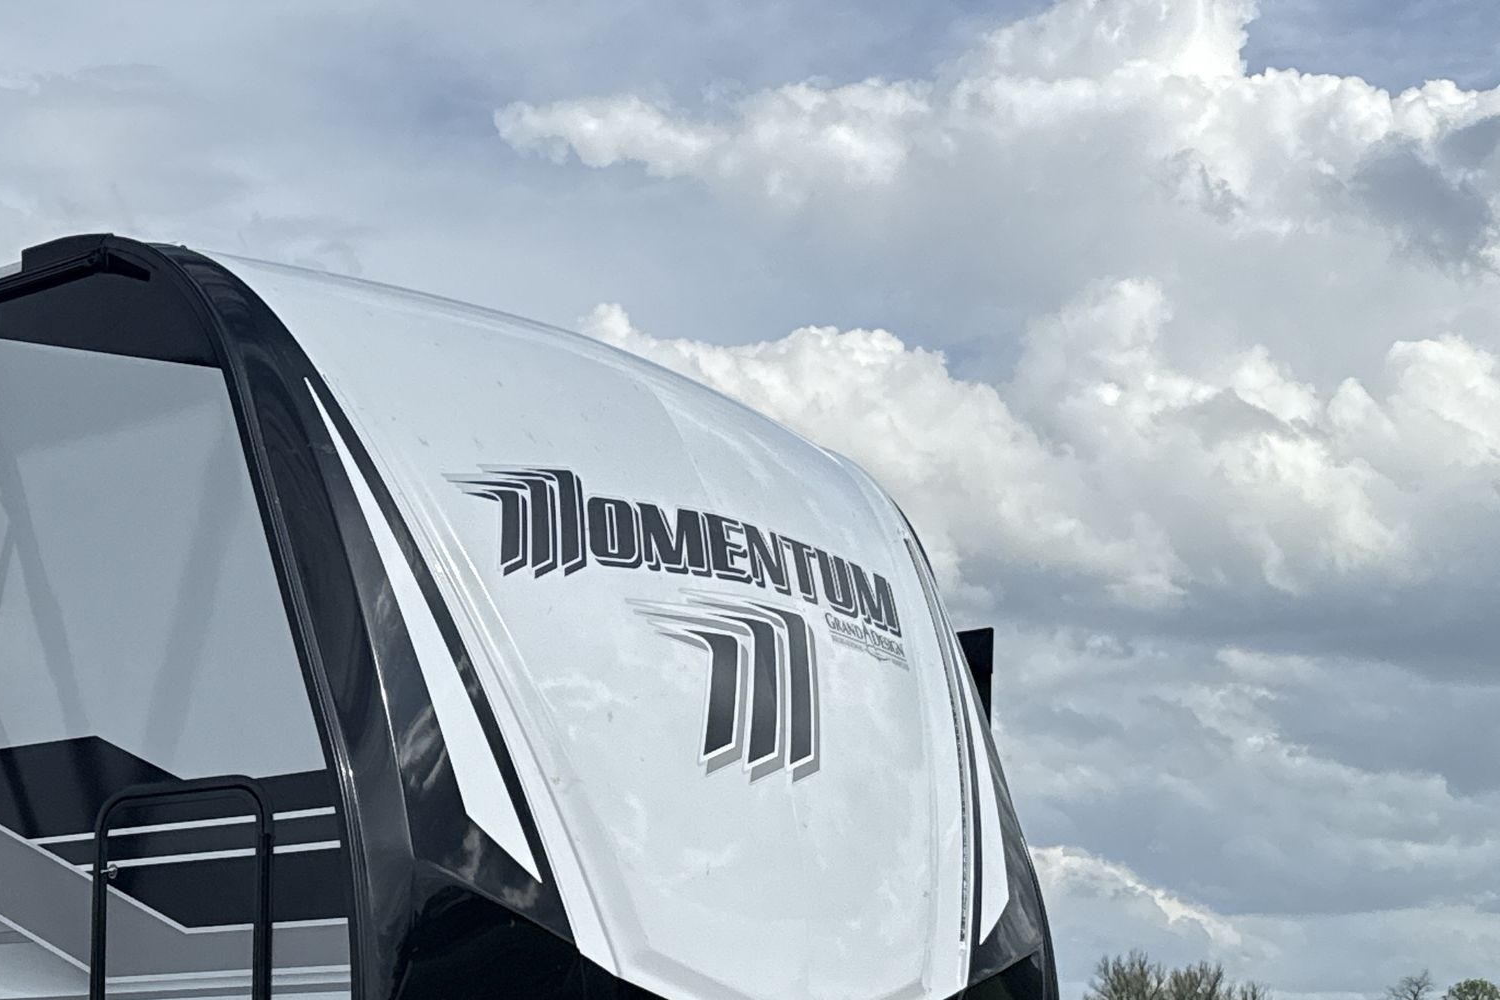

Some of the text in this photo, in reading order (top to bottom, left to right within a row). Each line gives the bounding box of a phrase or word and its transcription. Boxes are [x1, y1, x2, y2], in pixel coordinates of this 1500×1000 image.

[444, 464, 903, 636] MOMENTUM
[824, 612, 864, 640] GRAND
[870, 628, 906, 658] DESIGN
